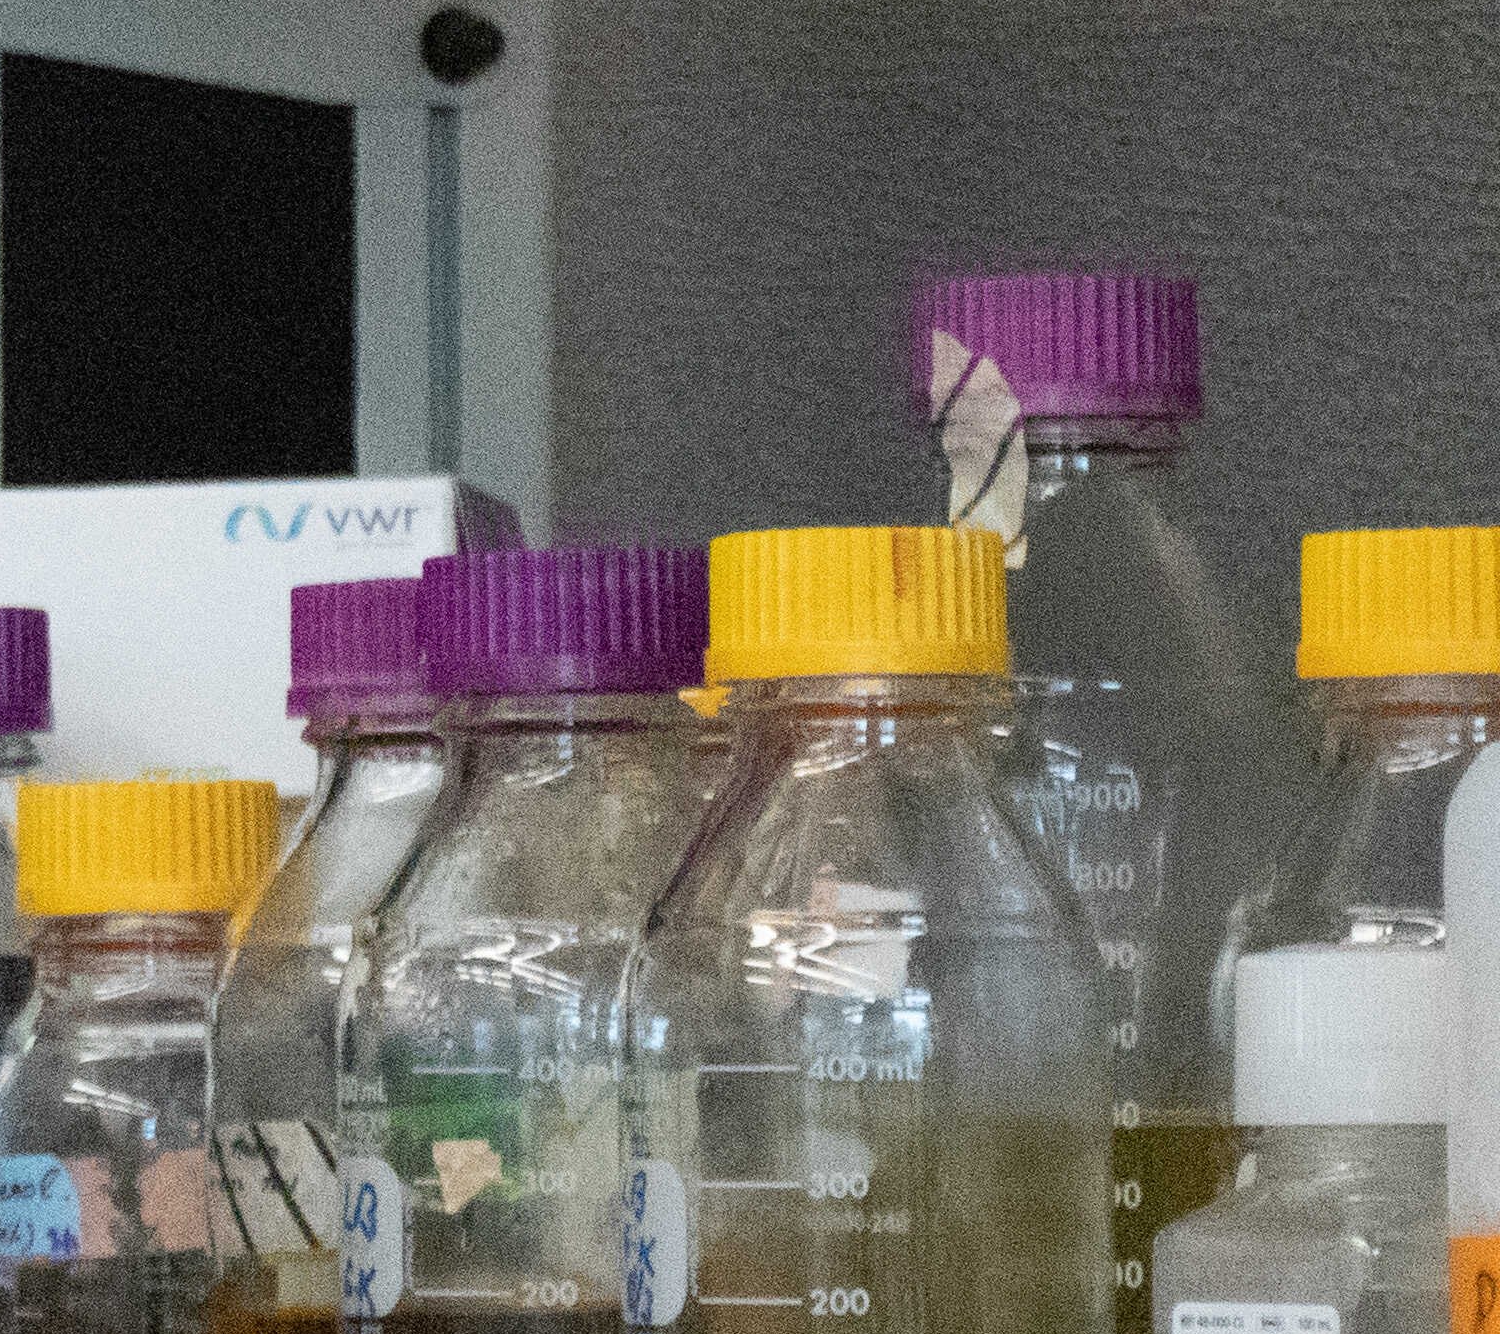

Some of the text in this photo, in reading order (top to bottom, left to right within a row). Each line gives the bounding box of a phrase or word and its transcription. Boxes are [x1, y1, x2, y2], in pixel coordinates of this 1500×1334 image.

[1074, 782, 1133, 812] 900
[1074, 862, 1134, 892] 800
[807, 1054, 868, 1082] 400
[807, 1170, 870, 1200] 300
[519, 1281, 579, 1308] 200
[809, 1286, 871, 1316] 200
